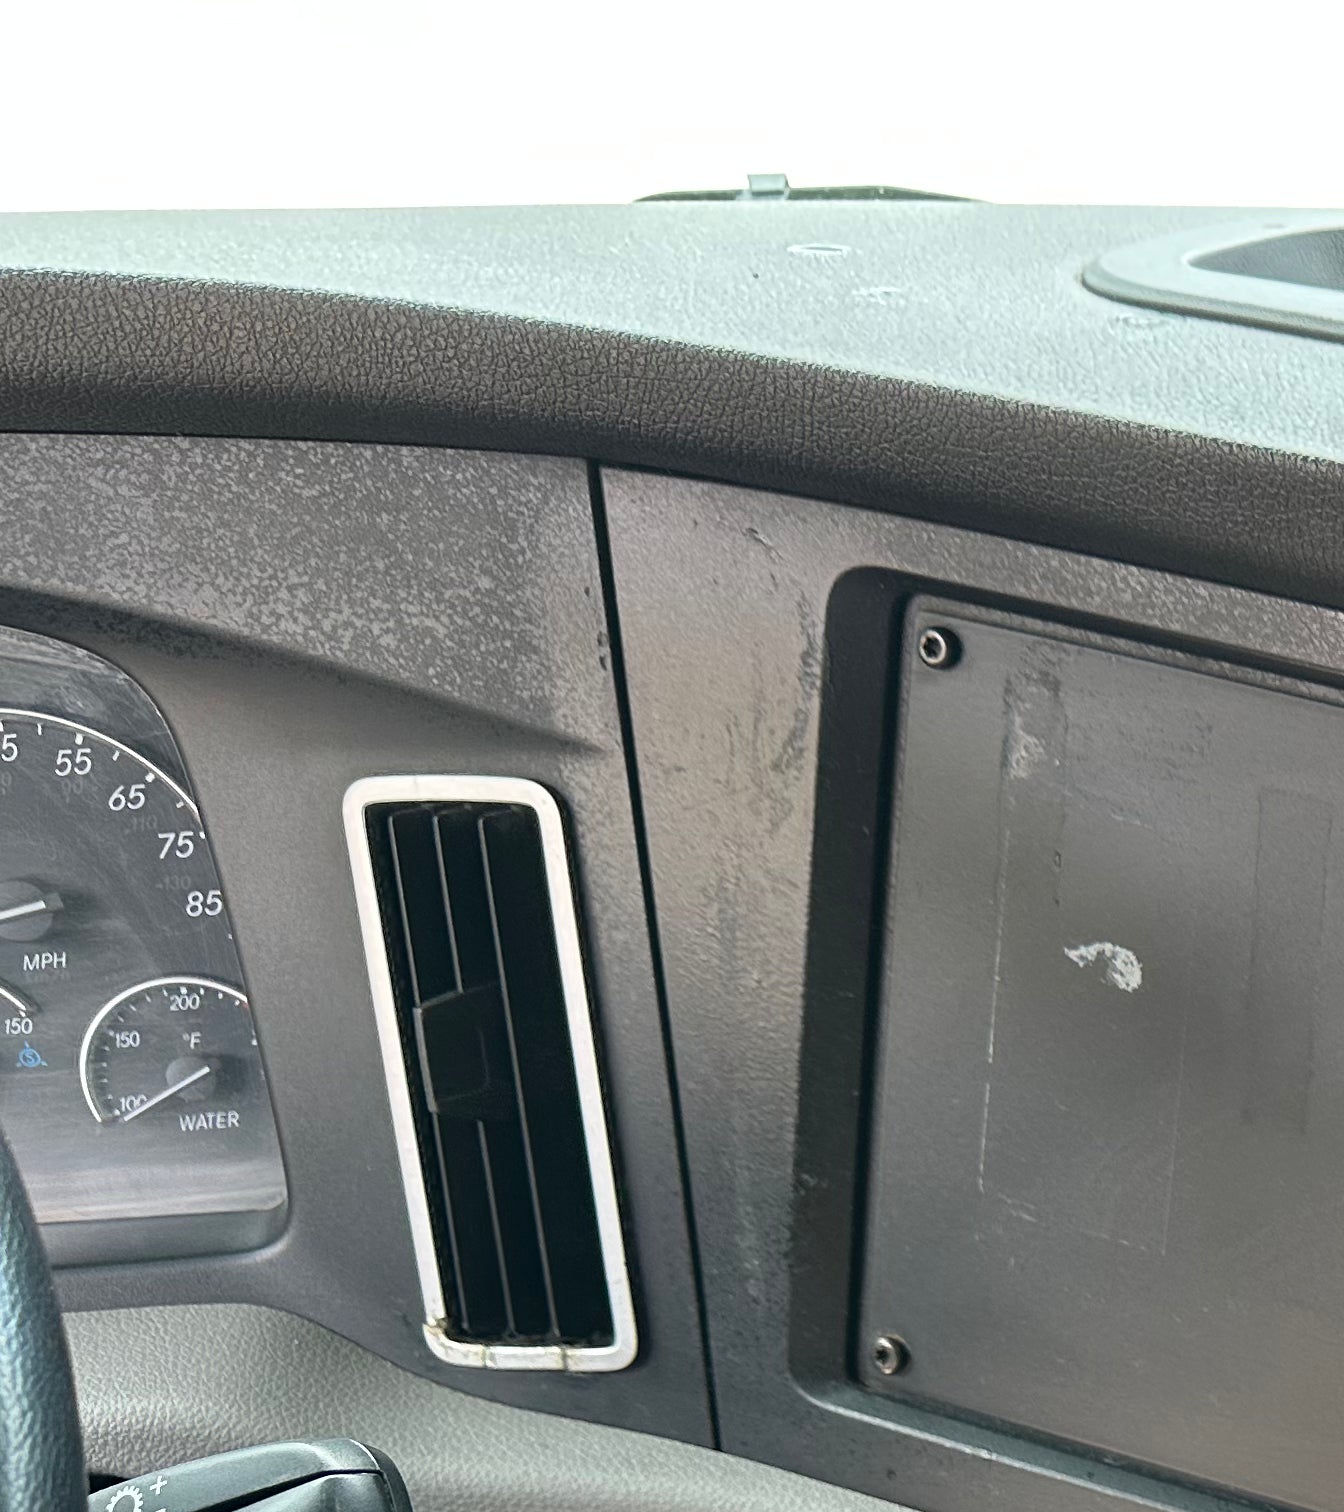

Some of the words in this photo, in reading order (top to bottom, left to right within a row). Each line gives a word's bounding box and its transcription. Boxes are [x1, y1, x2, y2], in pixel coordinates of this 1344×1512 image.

[54, 748, 92, 776] 55
[108, 783, 146, 811] 65
[158, 831, 194, 859] 75
[185, 890, 224, 917] 85
[23, 951, 67, 971] MPH
[170, 995, 200, 1011] 200
[5, 1018, 33, 1034] 150
[115, 1031, 140, 1048] 150
[179, 1112, 240, 1131] WATER
